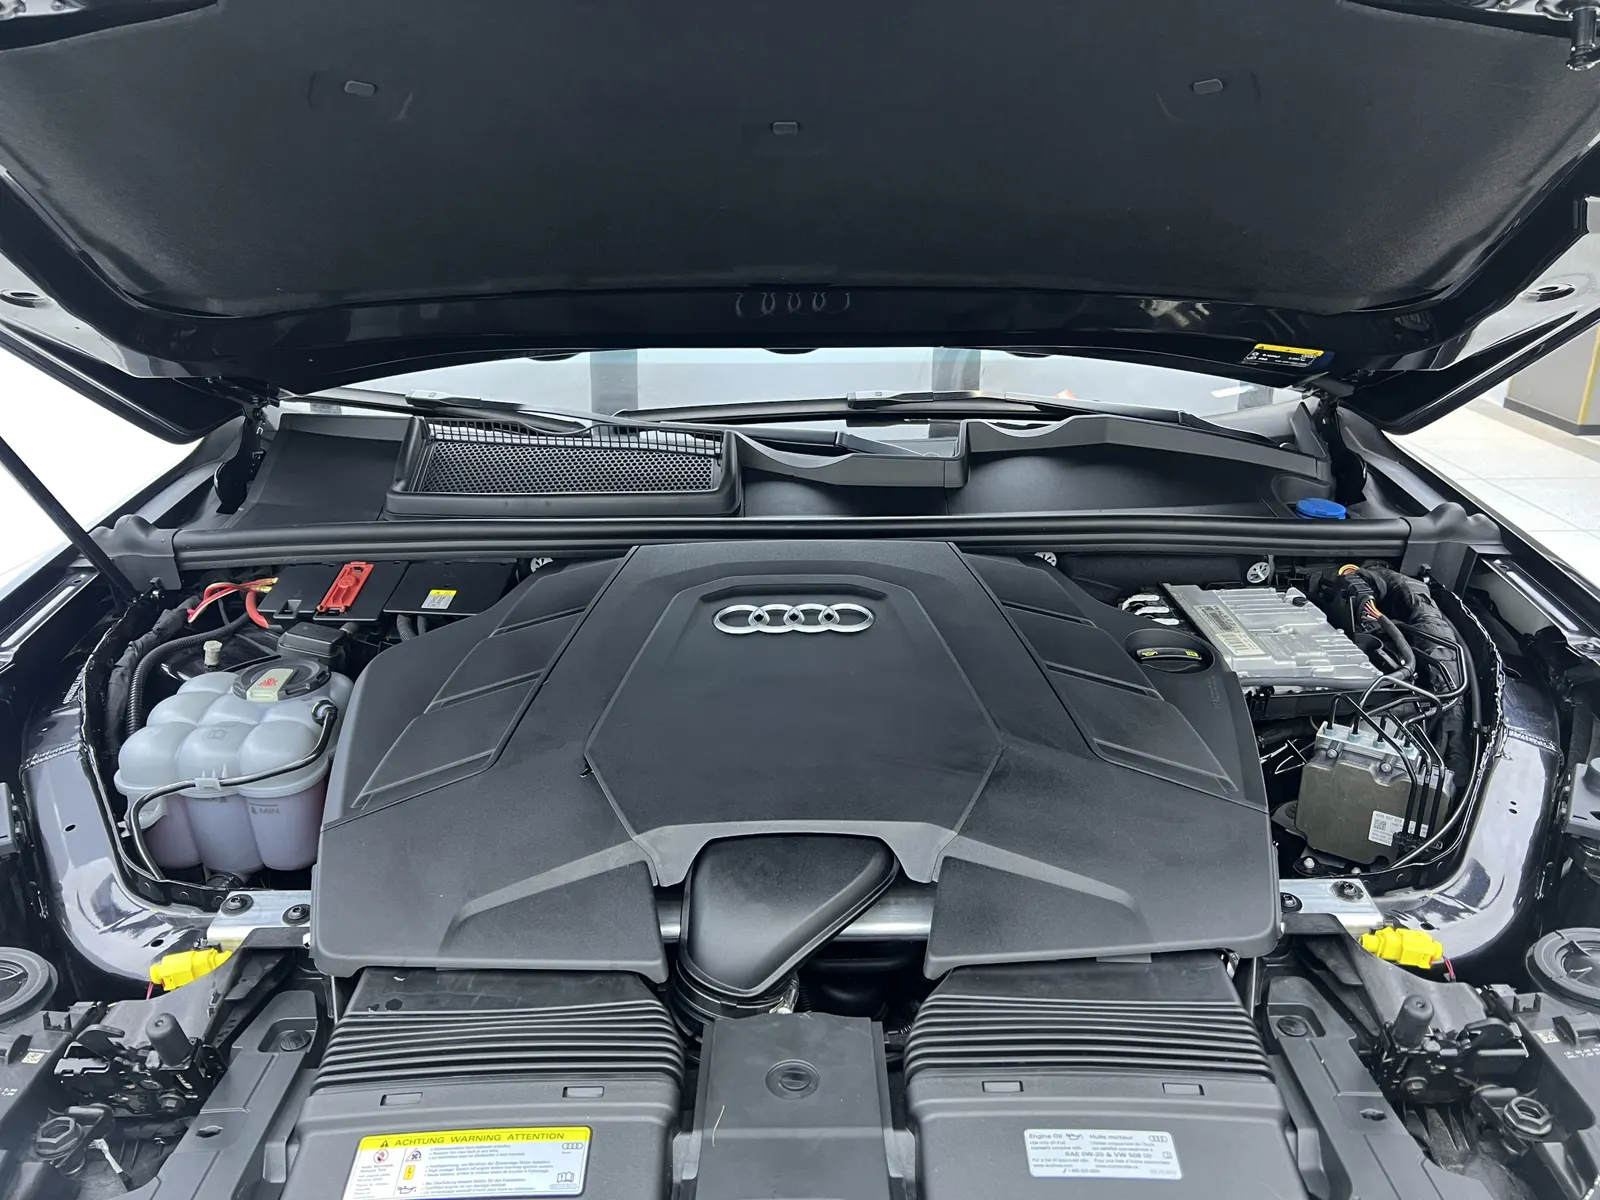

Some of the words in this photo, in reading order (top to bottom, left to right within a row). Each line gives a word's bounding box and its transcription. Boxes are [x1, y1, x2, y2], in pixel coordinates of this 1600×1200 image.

[394, 1137, 445, 1147] ACHTUNG
[450, 1134, 502, 1143] WARNING
[506, 1132, 565, 1141] ATTENTION
